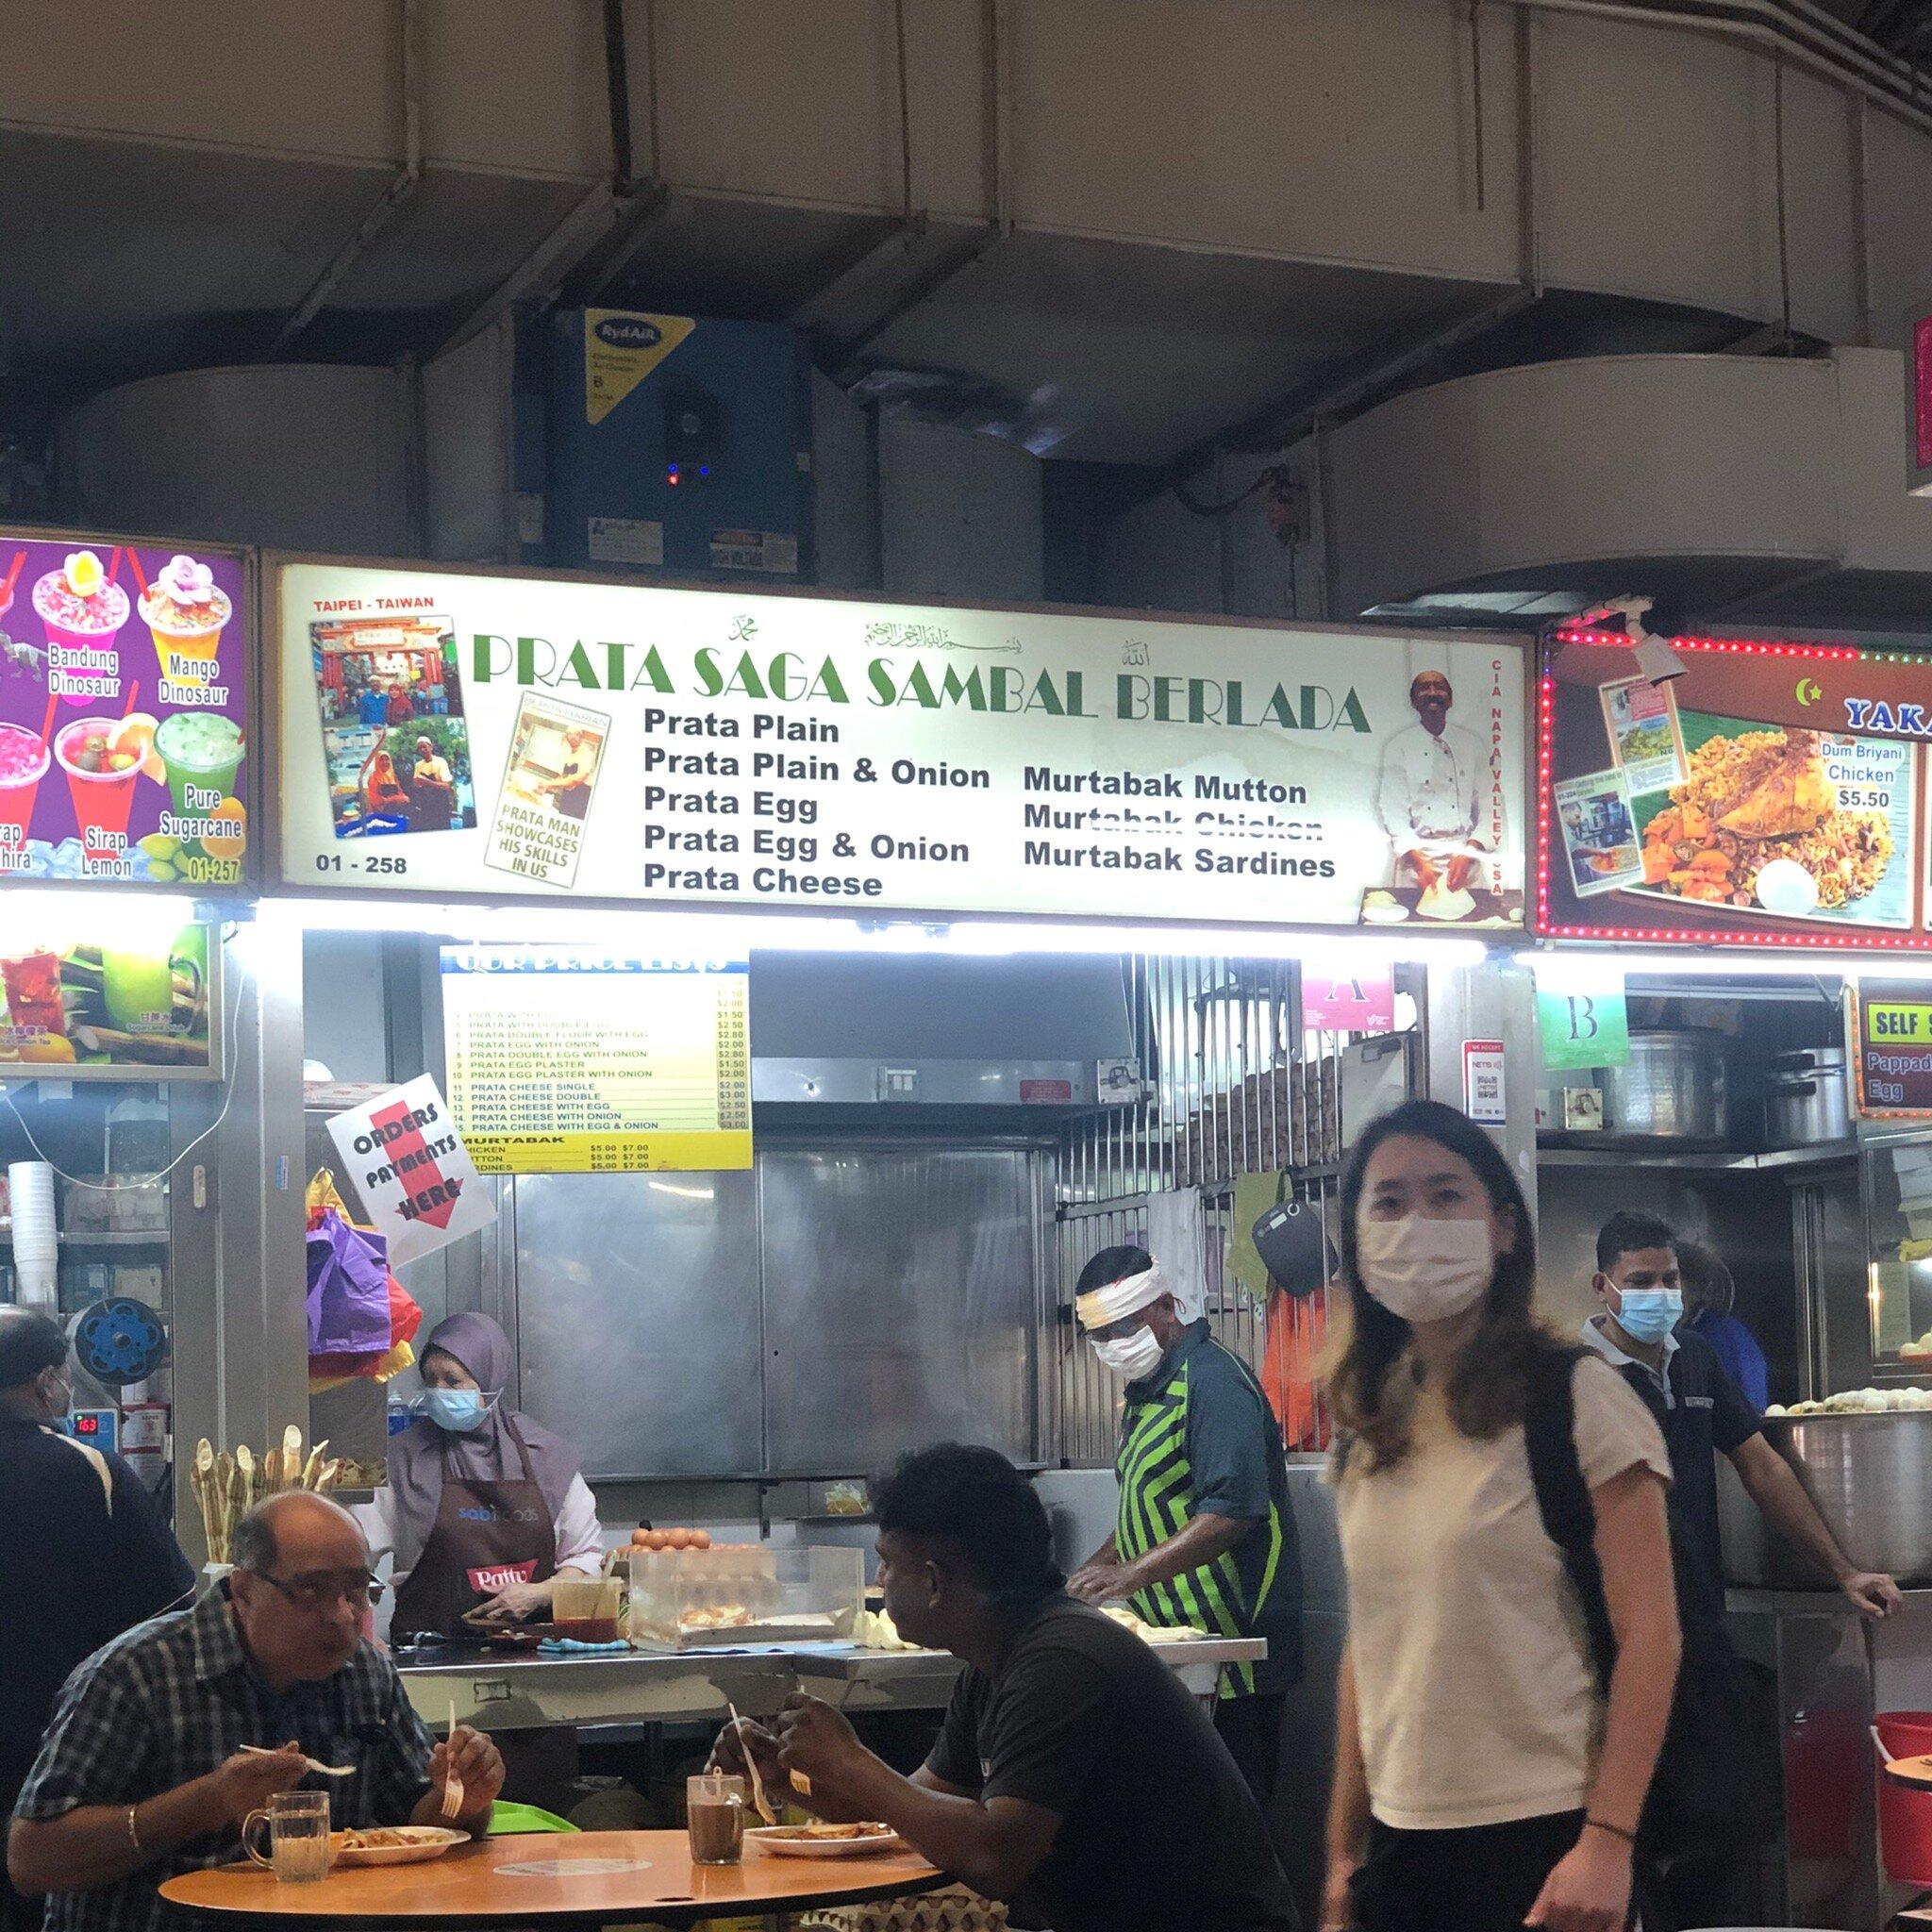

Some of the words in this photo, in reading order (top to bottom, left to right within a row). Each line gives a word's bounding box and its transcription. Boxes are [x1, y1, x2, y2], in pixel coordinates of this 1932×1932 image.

[313, 599, 362, 612] TAIPEI
[375, 596, 434, 609] TAIWAN
[49, 646, 119, 674] Bandung
[170, 655, 219, 680] Mango
[50, 673, 120, 696] Dinosaur
[160, 682, 228, 705] Dinosaur
[474, 635, 676, 695] PRATA
[693, 648, 850, 705] SAGA
[867, 658, 1099, 718] SAMBAL
[1117, 673, 1373, 733] BERLADA
[1491, 660, 1502, 697] CIA
[644, 708, 740, 738] Prata
[753, 713, 840, 743] Plain
[1845, 700, 1932, 733] YAK
[1491, 708, 1502, 758] NAPA
[1822, 743, 1853, 758] Dum
[1857, 745, 1903, 761] Briyani
[644, 747, 740, 776] Prata
[753, 752, 840, 782] Plain
[853, 758, 877, 784] &
[891, 758, 991, 789] Onion
[1828, 764, 1894, 782] Chicken
[186, 785, 221, 808] Pure
[1024, 766, 1183, 798] Murtabak
[1194, 774, 1307, 805] Mutton
[1840, 790, 1890, 808] $5.50
[502, 804, 544, 826] PRATA
[547, 817, 580, 837] MAN
[644, 786, 740, 815] Prata
[753, 791, 819, 825] Egg
[1491, 770, 1502, 846] VALLEY
[0, 825, 21, 847] ap
[87, 827, 126, 854] Sirap
[161, 813, 242, 839] Sugarcane
[496, 820, 578, 853] SHOWCASES
[499, 838, 521, 854] HIS
[525, 844, 568, 867] SKILLS
[644, 824, 740, 854] Prata
[753, 829, 819, 862] Egg
[832, 832, 858, 858] &
[870, 834, 970, 863] Onion
[2, 849, 31, 869] hira
[82, 855, 131, 876] Lemon
[316, 854, 341, 873] 01
[365, 857, 408, 874] 258
[511, 857, 527, 873] IN
[530, 861, 548, 878] US
[1024, 841, 1183, 871] Murtabak
[1194, 848, 1336, 878] Sardines
[644, 863, 740, 891] Prata
[753, 868, 883, 897] Cheese
[1491, 863, 1503, 895] SA
[1567, 995, 1599, 1040] B
[1875, 1011, 1919, 1036] SELF
[1869, 1079, 1904, 1102] Egg
[353, 1103, 439, 1155] ORDERS
[366, 1134, 457, 1189] PAYMENTS
[398, 1177, 461, 1222] HERE
